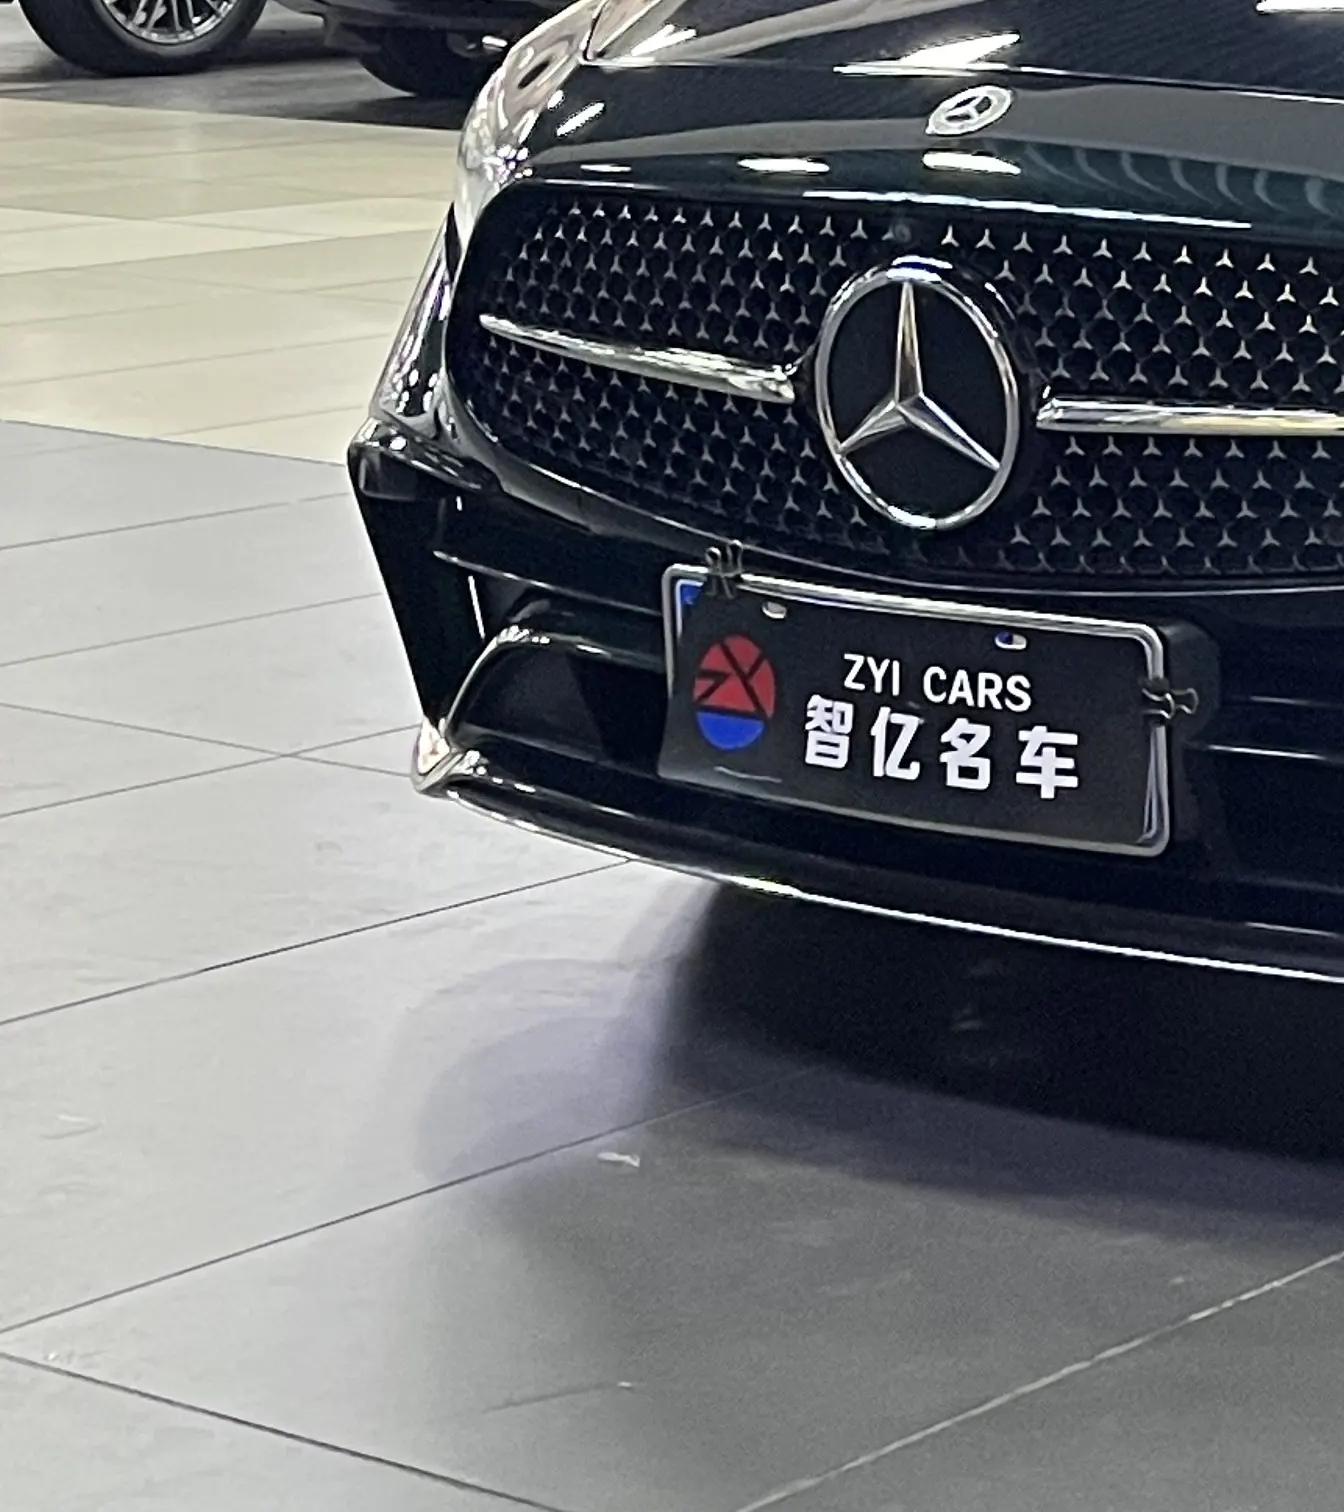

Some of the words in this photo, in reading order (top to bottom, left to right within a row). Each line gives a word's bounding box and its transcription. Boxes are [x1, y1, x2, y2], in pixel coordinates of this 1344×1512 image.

[843, 652, 902, 699] ZYI
[923, 665, 1033, 713] CARS
[804, 693, 1080, 800] 智亿名车
